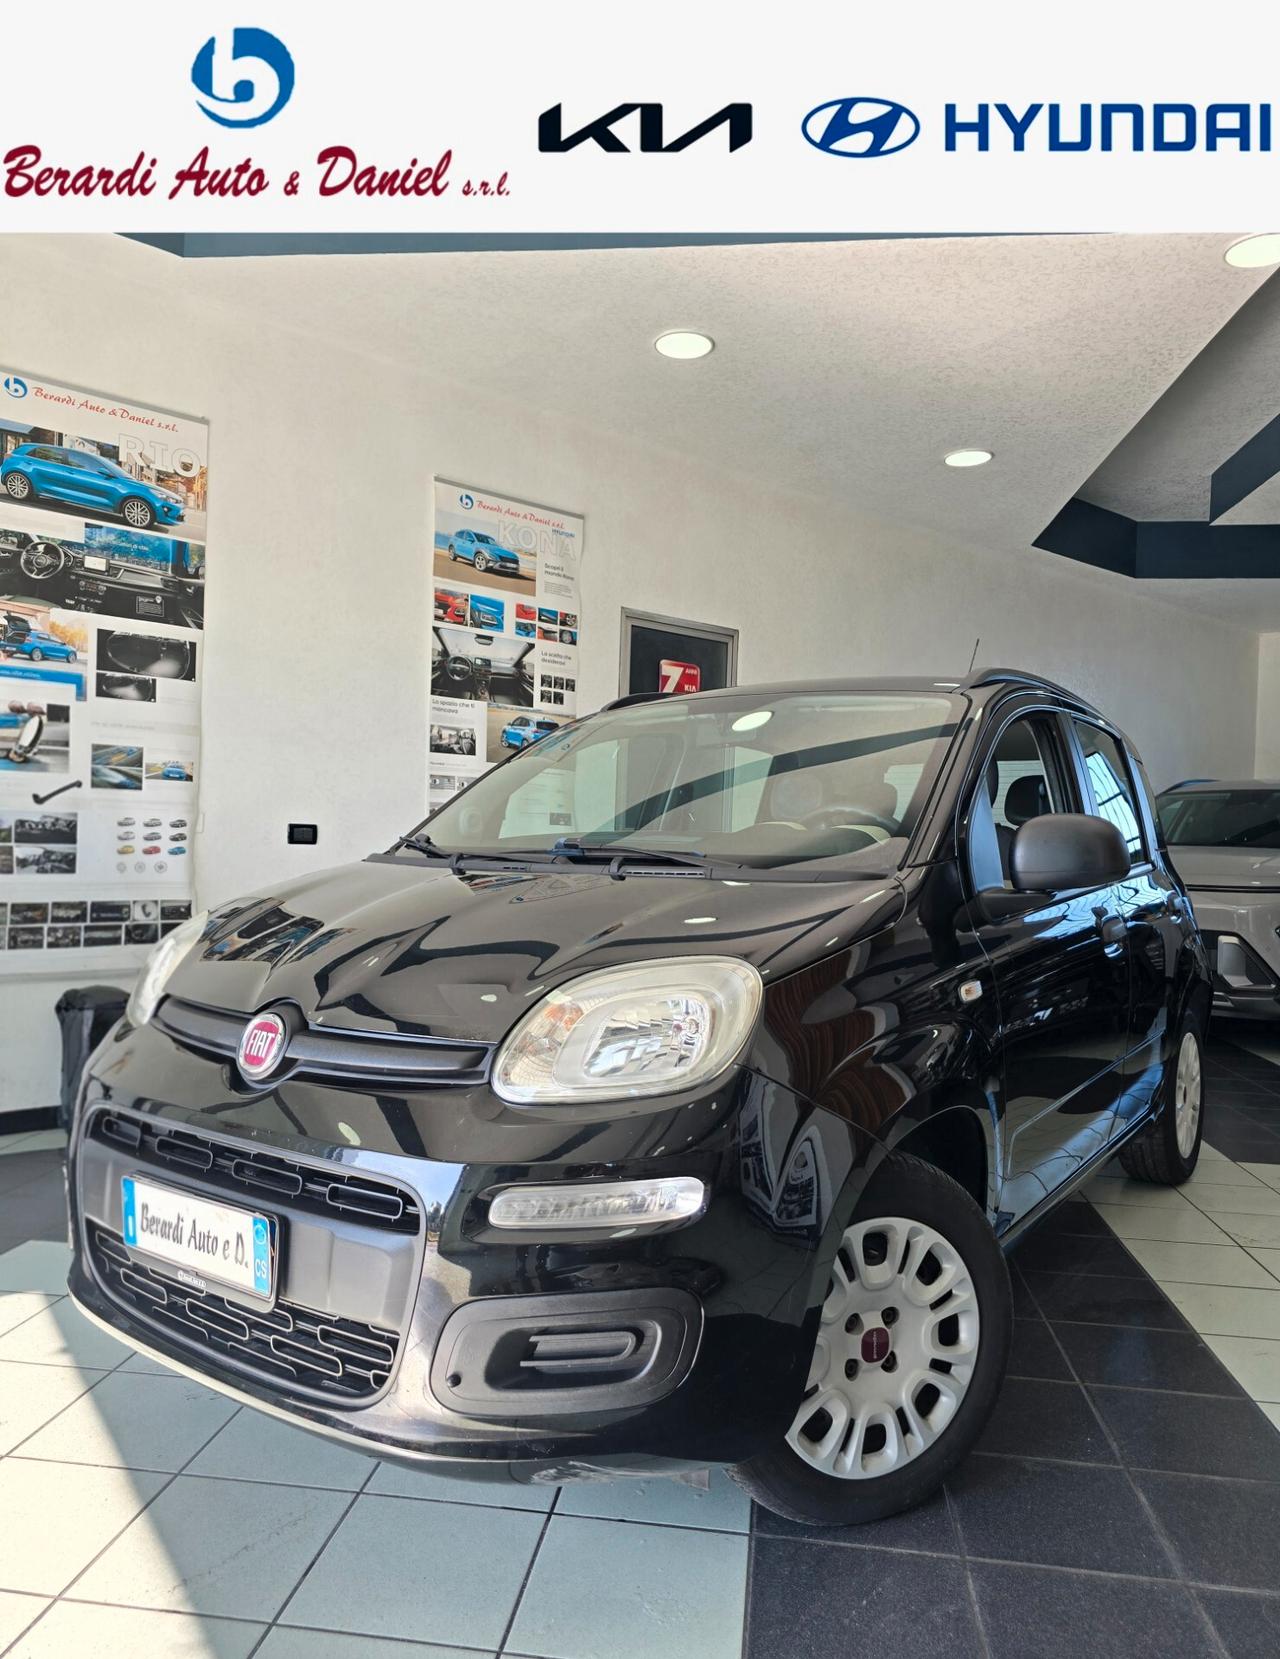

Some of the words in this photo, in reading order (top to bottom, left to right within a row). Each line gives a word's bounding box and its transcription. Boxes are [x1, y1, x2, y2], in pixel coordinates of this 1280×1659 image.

[32, 387, 76, 406] Berardi
[77, 400, 106, 414] Auto
[108, 408, 118, 418] &
[118, 407, 155, 426] Daniel
[157, 421, 179, 433] s.r.l.
[118, 433, 201, 478] RIO
[476, 500, 503, 514] Berardi
[503, 507, 521, 519] Auto
[528, 512, 551, 526] Daniel
[498, 520, 577, 561] KONA
[661, 664, 684, 693] 7
[684, 684, 697, 693] KIA
[246, 1029, 276, 1058] FIAT
[141, 1202, 184, 1246] Berardi
[187, 1219, 218, 1256] Auto
[222, 1238, 231, 1260] e
[235, 1231, 249, 1269] D.
[254, 1258, 268, 1279] CS
